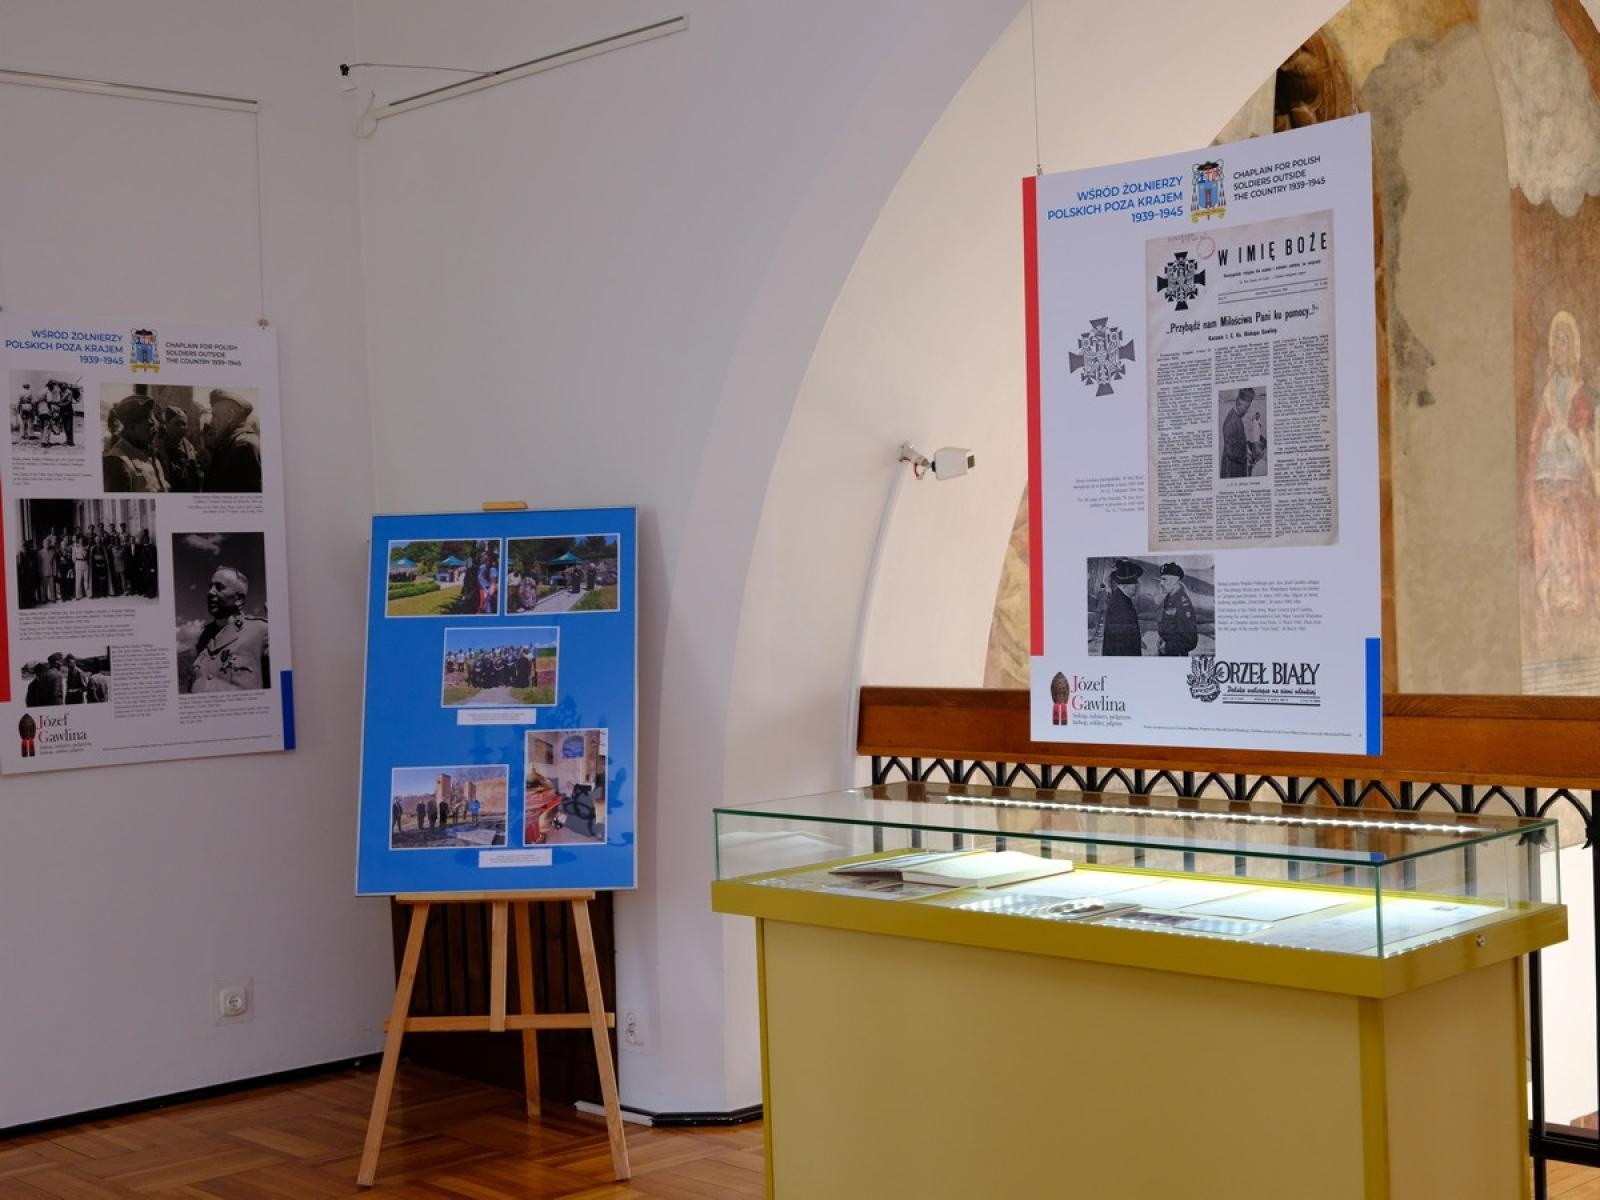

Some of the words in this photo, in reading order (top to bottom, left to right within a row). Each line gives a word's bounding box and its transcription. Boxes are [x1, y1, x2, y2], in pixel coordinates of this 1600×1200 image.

[1233, 165, 1273, 179] CHAPLAIN
[1275, 162, 1290, 171] FOR
[1292, 155, 1321, 168] POLISH
[1077, 185, 1120, 201] WŚRÓD
[1123, 176, 1183, 195] ŻOŁNIERZY
[1233, 176, 1271, 191] SOLDIERS
[1272, 169, 1306, 183] OUTSIDE
[1233, 192, 1249, 201] THE
[1250, 184, 1287, 198] COUNTRY
[1047, 203, 1101, 220] POLSKICH
[1105, 200, 1135, 212] POZA
[1138, 191, 1183, 207] KRAJEM
[1218, 249, 1228, 267] W
[1238, 241, 1275, 263] IMIĘ
[1285, 231, 1327, 256] BOŻE
[1203, 320, 1217, 329] nam
[1255, 309, 1271, 322] Pani
[1274, 309, 1282, 320] ku
[32, 329, 69, 340] WŚRÓD
[72, 331, 123, 342] ŻOŁNIERZY
[5, 340, 53, 351] POLSKICH
[56, 343, 82, 352] POZA
[84, 345, 124, 354] KRAJEM
[1214, 660, 1269, 684] ORZEŁ
[1272, 662, 1321, 685] BIAŁY
[1070, 675, 1108, 693] Józef
[1071, 695, 1126, 711] Gawlina
[36, 712, 70, 730] Józef
[38, 728, 87, 743] Gawlina
